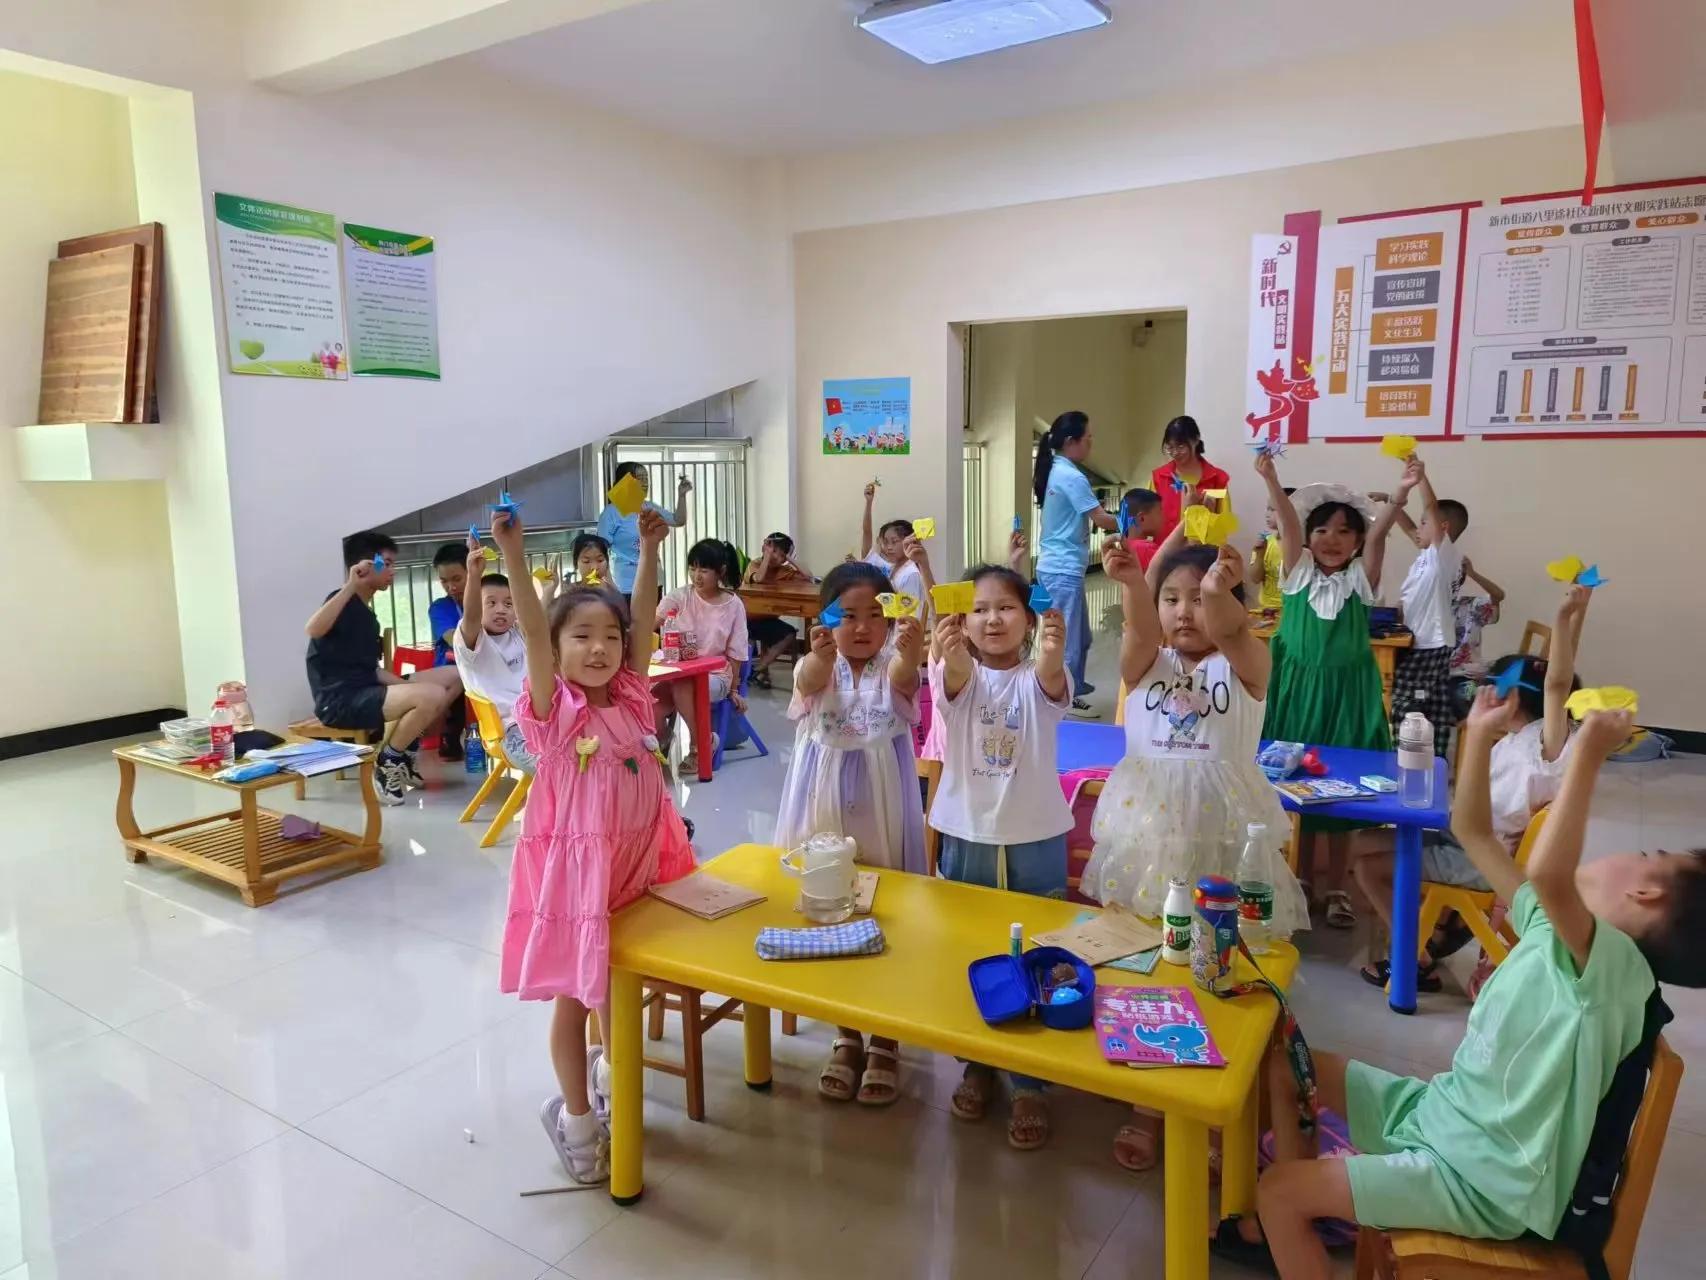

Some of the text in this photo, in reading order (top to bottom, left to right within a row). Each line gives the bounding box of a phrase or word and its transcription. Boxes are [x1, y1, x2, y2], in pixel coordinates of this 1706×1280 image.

[1261, 258, 1277, 307] 新时代
[1332, 289, 1351, 373] 五大实践行动
[1102, 998, 1185, 1015] 专注力
